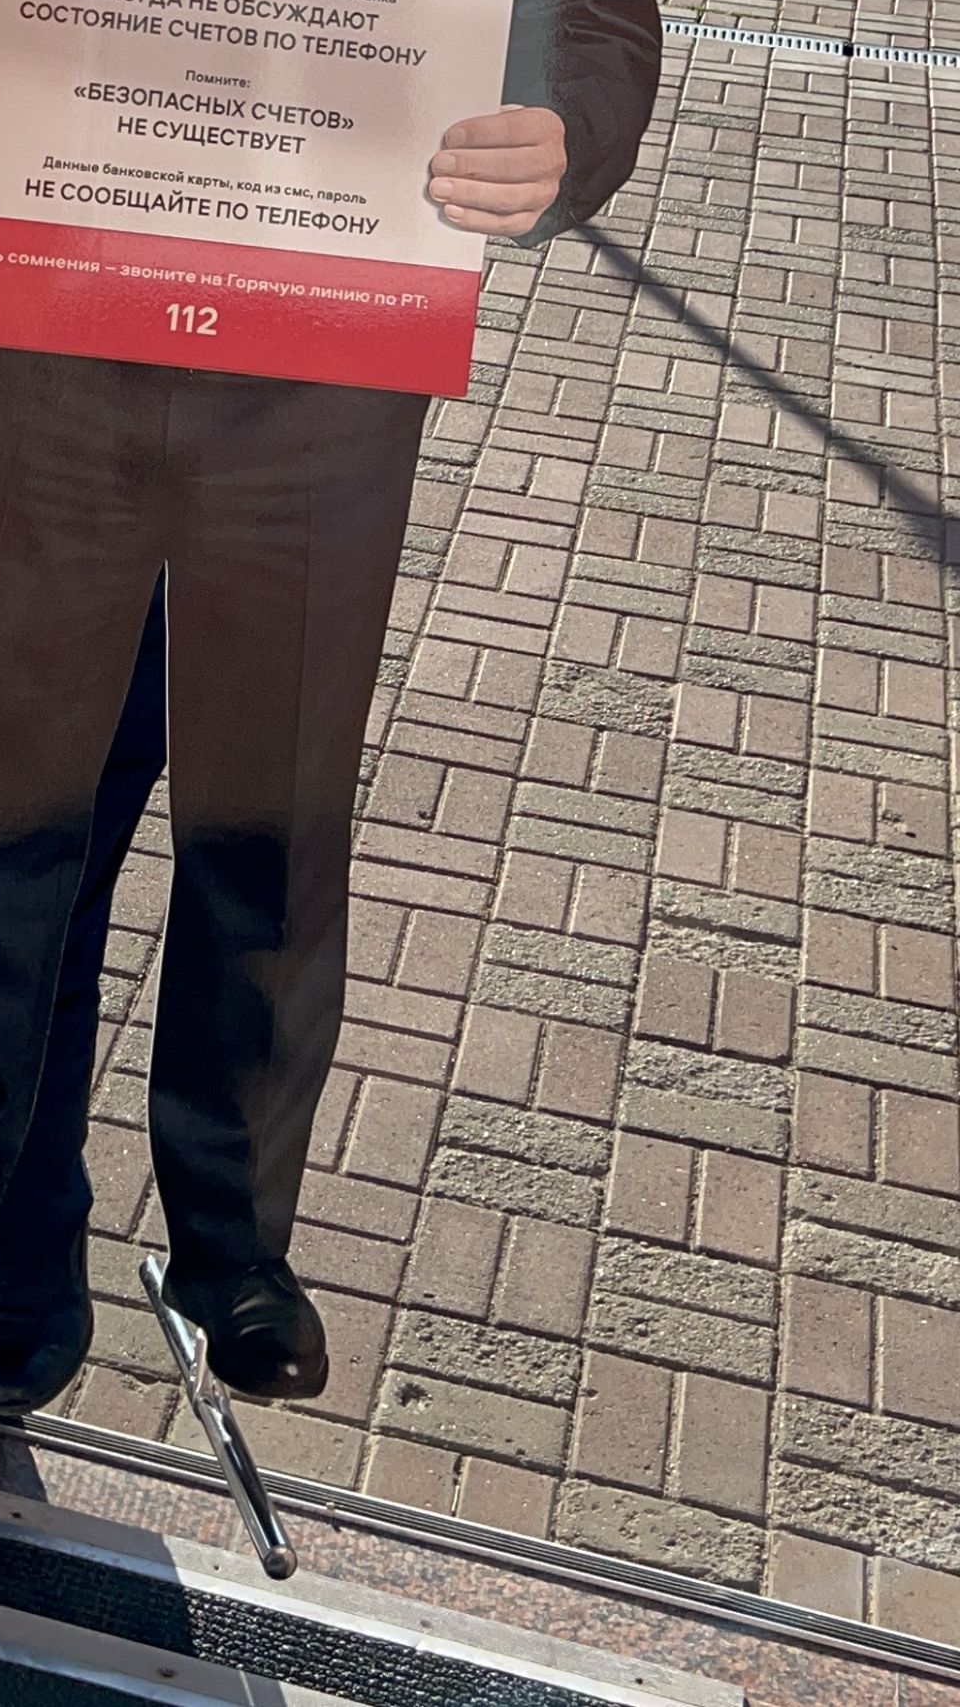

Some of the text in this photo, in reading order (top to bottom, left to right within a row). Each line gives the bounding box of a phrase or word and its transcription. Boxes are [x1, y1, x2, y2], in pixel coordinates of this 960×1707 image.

[19, 0, 427, 66] СОСТОЯНИЕ СЧЕТОВ ПО ТЕЛЕФОНУ
[185, 69, 251, 88] Помните:
[74, 82, 354, 130] «БЕЗОПАСНЫХ СЧЕТОВ»
[117, 115, 306, 154] НЕ СУЩЕСТВУЕТ
[42, 155, 367, 204] Данные банковской карты, код из смс, пароль
[25, 178, 380, 235] НЕ СООБЩАЙТЕ ПО ТЕЛЕФОНУ
[7, 252, 100, 273] сомнения
[119, 265, 196, 284] звоните
[200, 274, 223, 287] на
[227, 273, 306, 297] Горячую
[308, 286, 371, 303] линию
[374, 293, 397, 306] по
[400, 293, 429, 310] РТ:
[166, 303, 218, 336] 112
